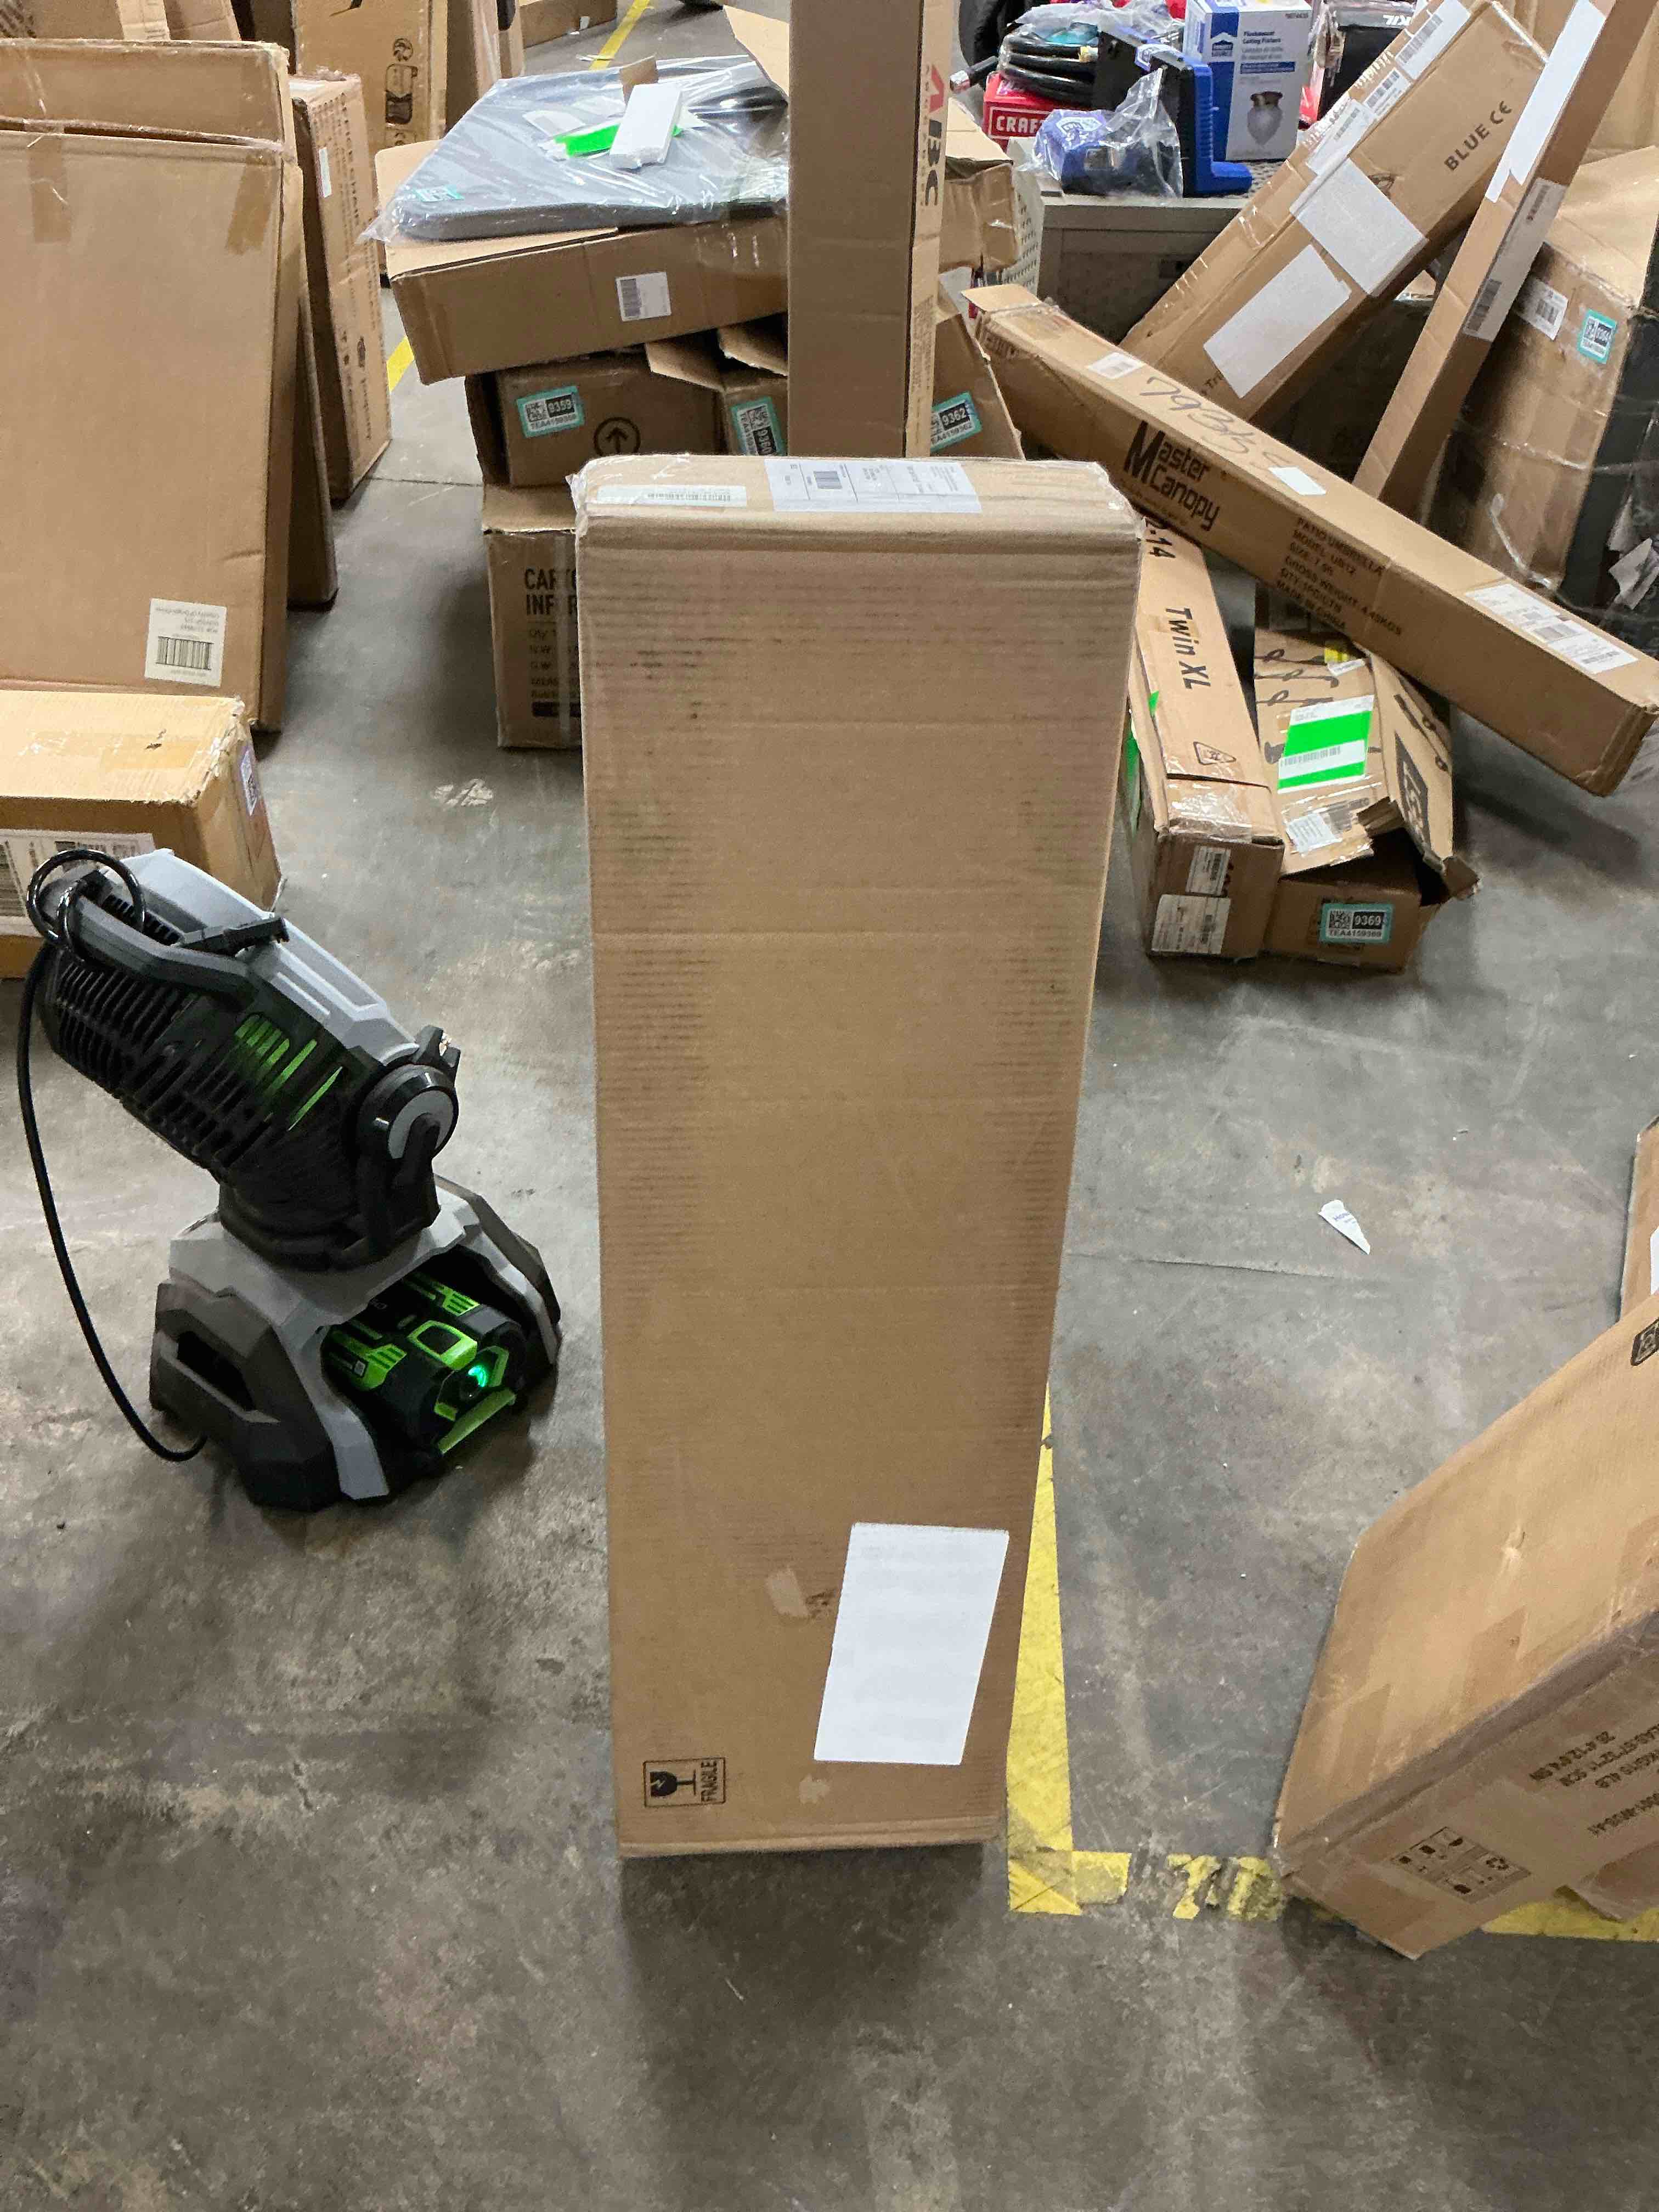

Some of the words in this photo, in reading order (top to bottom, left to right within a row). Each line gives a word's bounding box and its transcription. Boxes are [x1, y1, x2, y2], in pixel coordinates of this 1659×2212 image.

[1383, 14, 1413, 26] KIL
[996, 115, 1047, 133] CRAF
[1444, 123, 1490, 171] BLUE
[943, 408, 967, 426] 9362
[1124, 420, 1210, 484] Master
[1150, 464, 1221, 532] Canopy
[1165, 607, 1199, 656] Twin
[1178, 661, 1211, 690] XL
